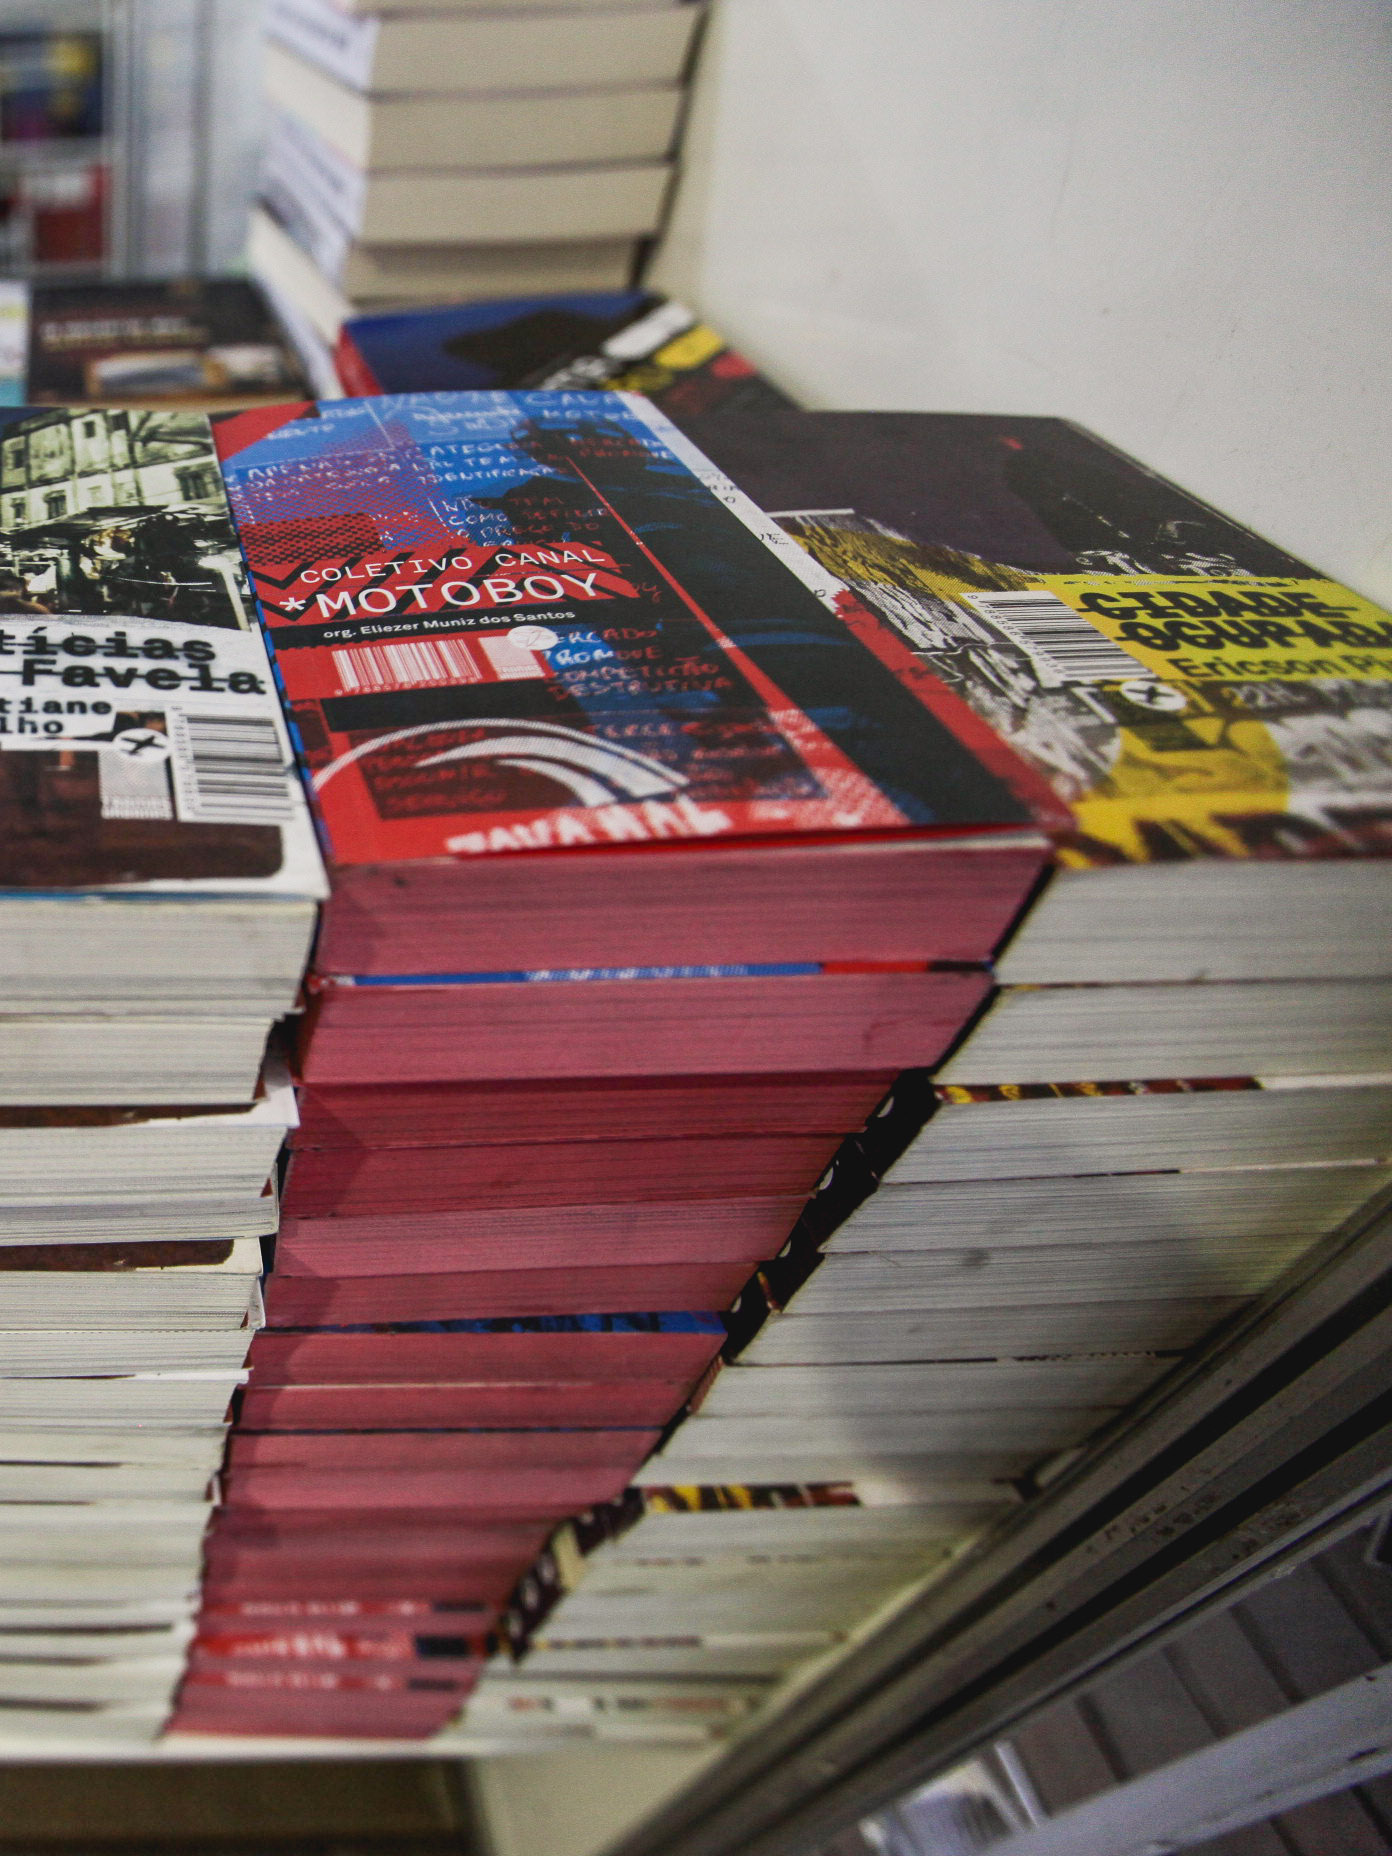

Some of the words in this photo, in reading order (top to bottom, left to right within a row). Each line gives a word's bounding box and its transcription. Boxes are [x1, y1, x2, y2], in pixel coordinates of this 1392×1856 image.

[300, 556, 472, 584] COLETIVO
[494, 549, 605, 568] CANAL
[1078, 591, 1353, 620] CIDADE
[323, 629, 357, 640] org.
[361, 621, 419, 635] Eliezer
[423, 616, 476, 629] Muniz
[479, 614, 509, 625] dos
[512, 610, 575, 623] Santos
[1118, 620, 1392, 651] OCUPAD
[21, 659, 267, 696] Favela
[1166, 654, 1348, 679] Ericson
[1339, 654, 1392, 675] Pi
